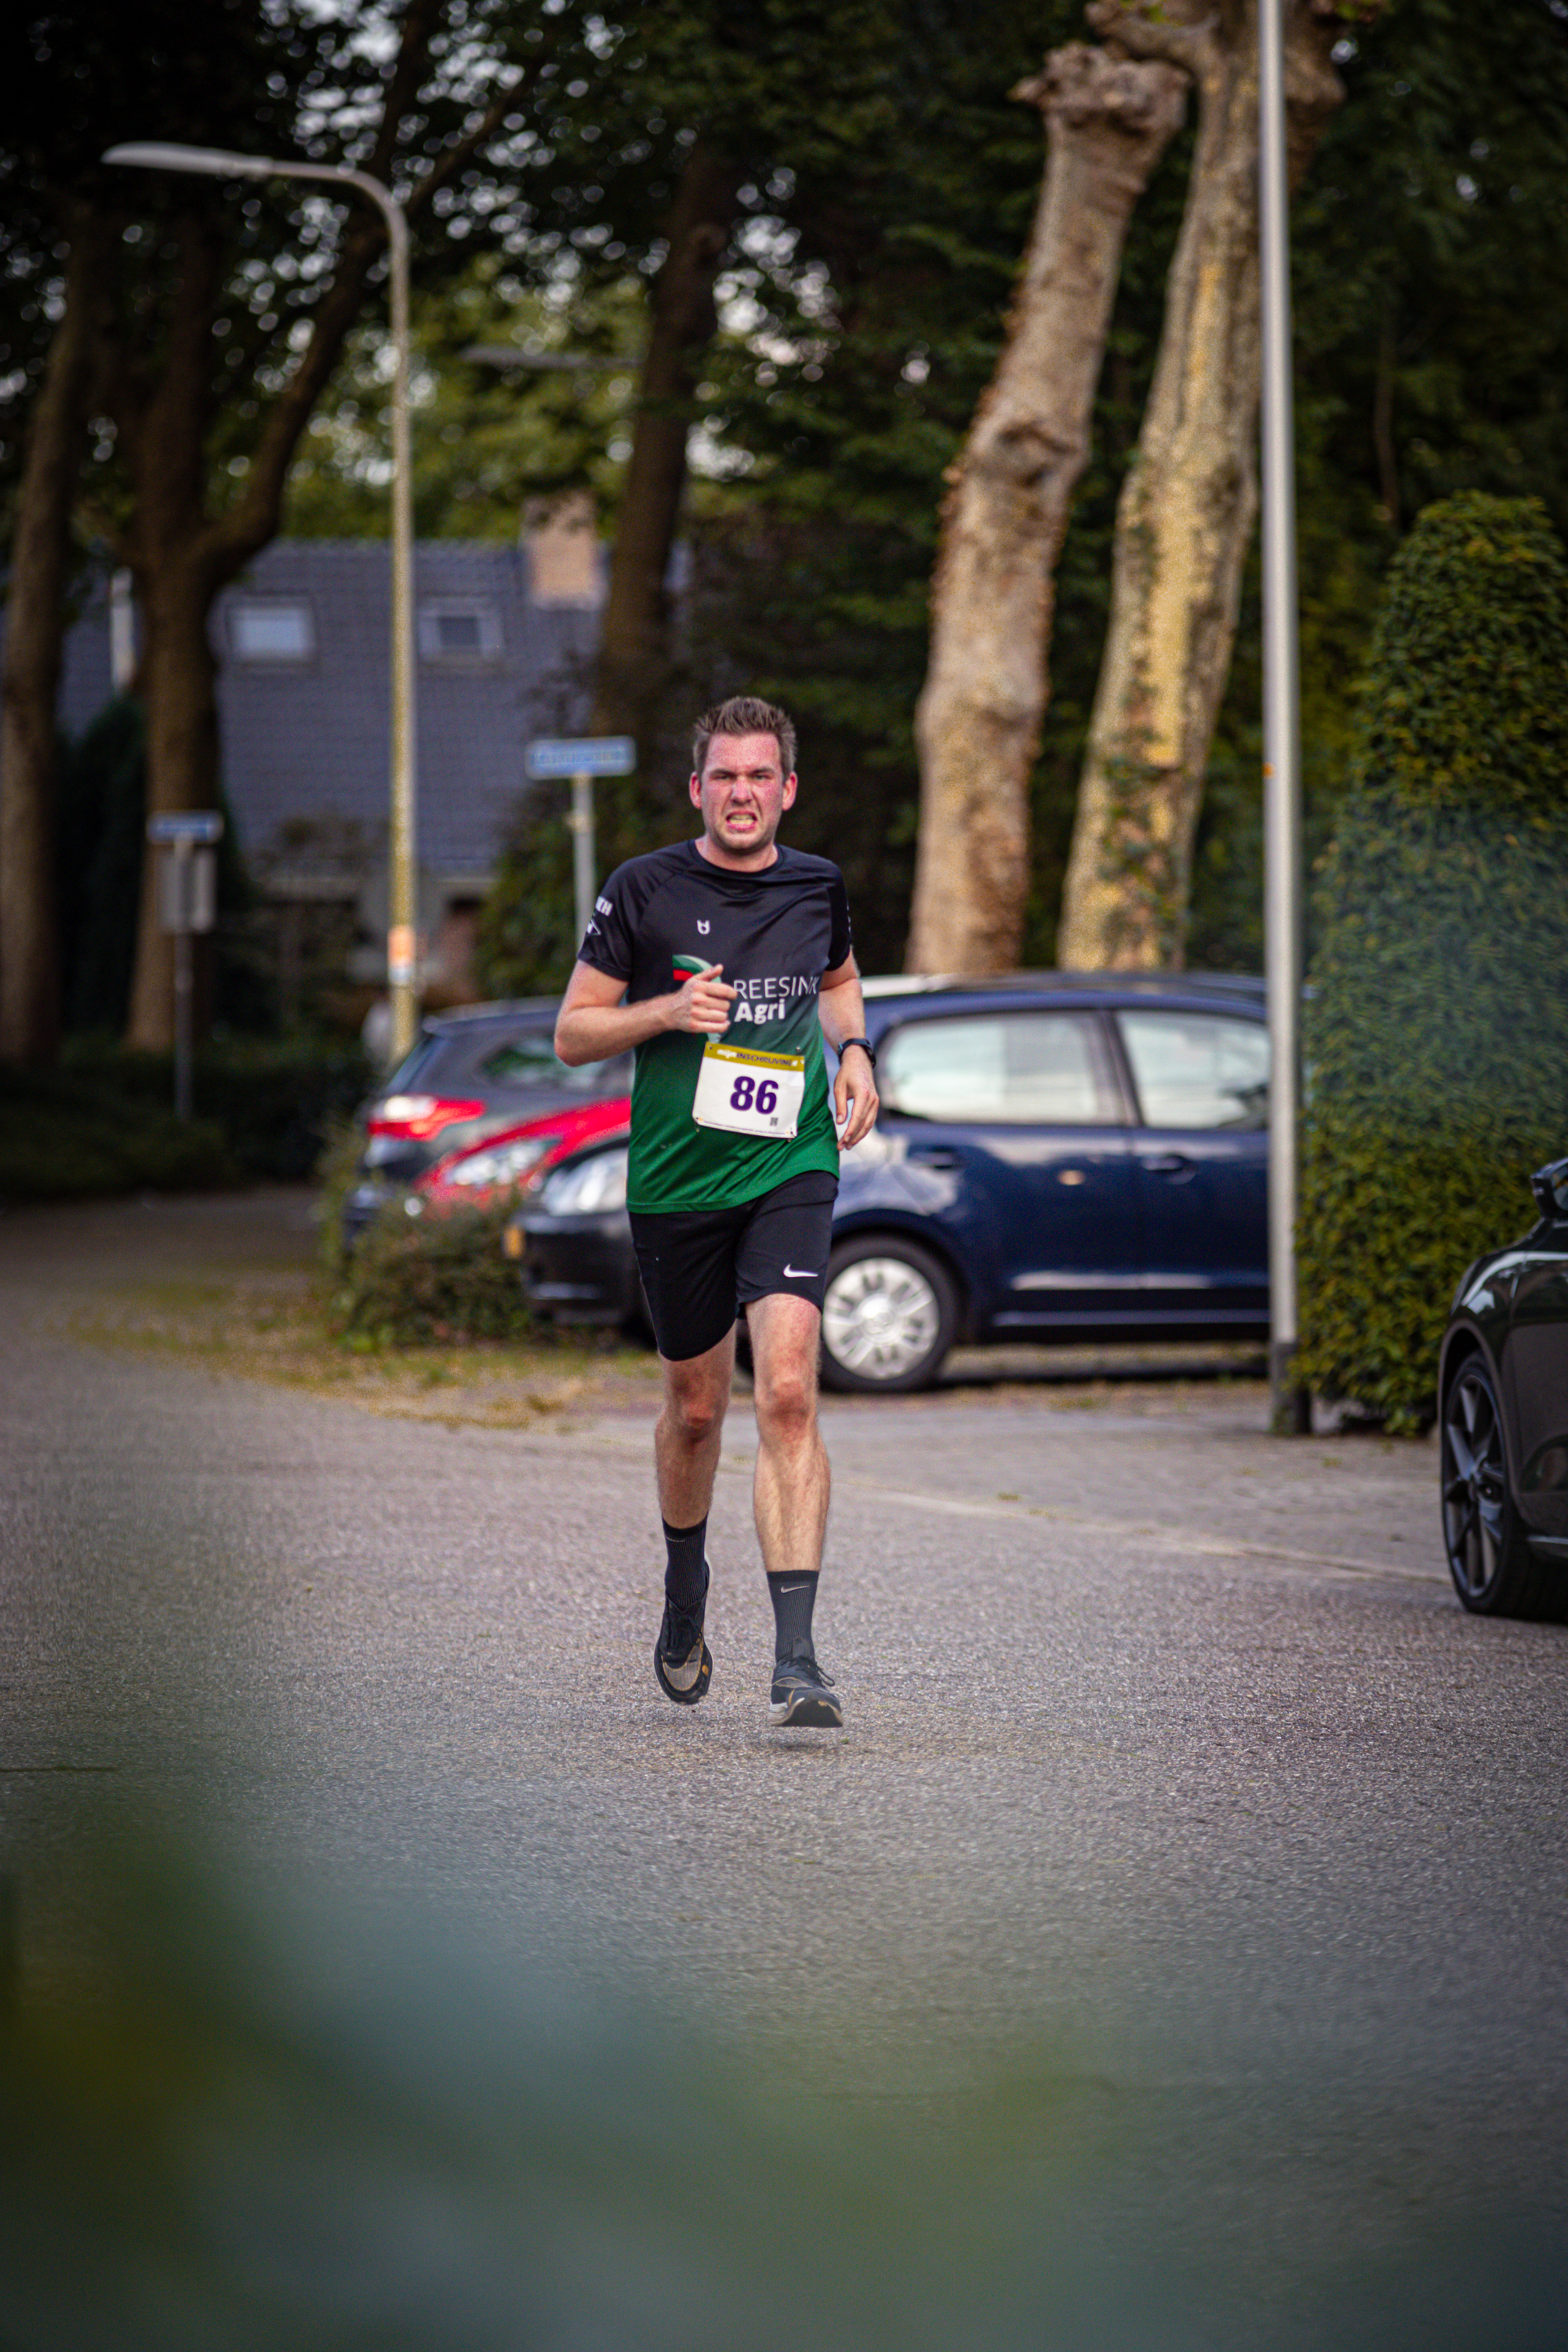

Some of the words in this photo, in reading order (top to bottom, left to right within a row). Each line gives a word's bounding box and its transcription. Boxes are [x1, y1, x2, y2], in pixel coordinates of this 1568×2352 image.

[733, 976, 820, 1000] REESINK
[734, 998, 785, 1025] Agri
[730, 1076, 779, 1115] 86
